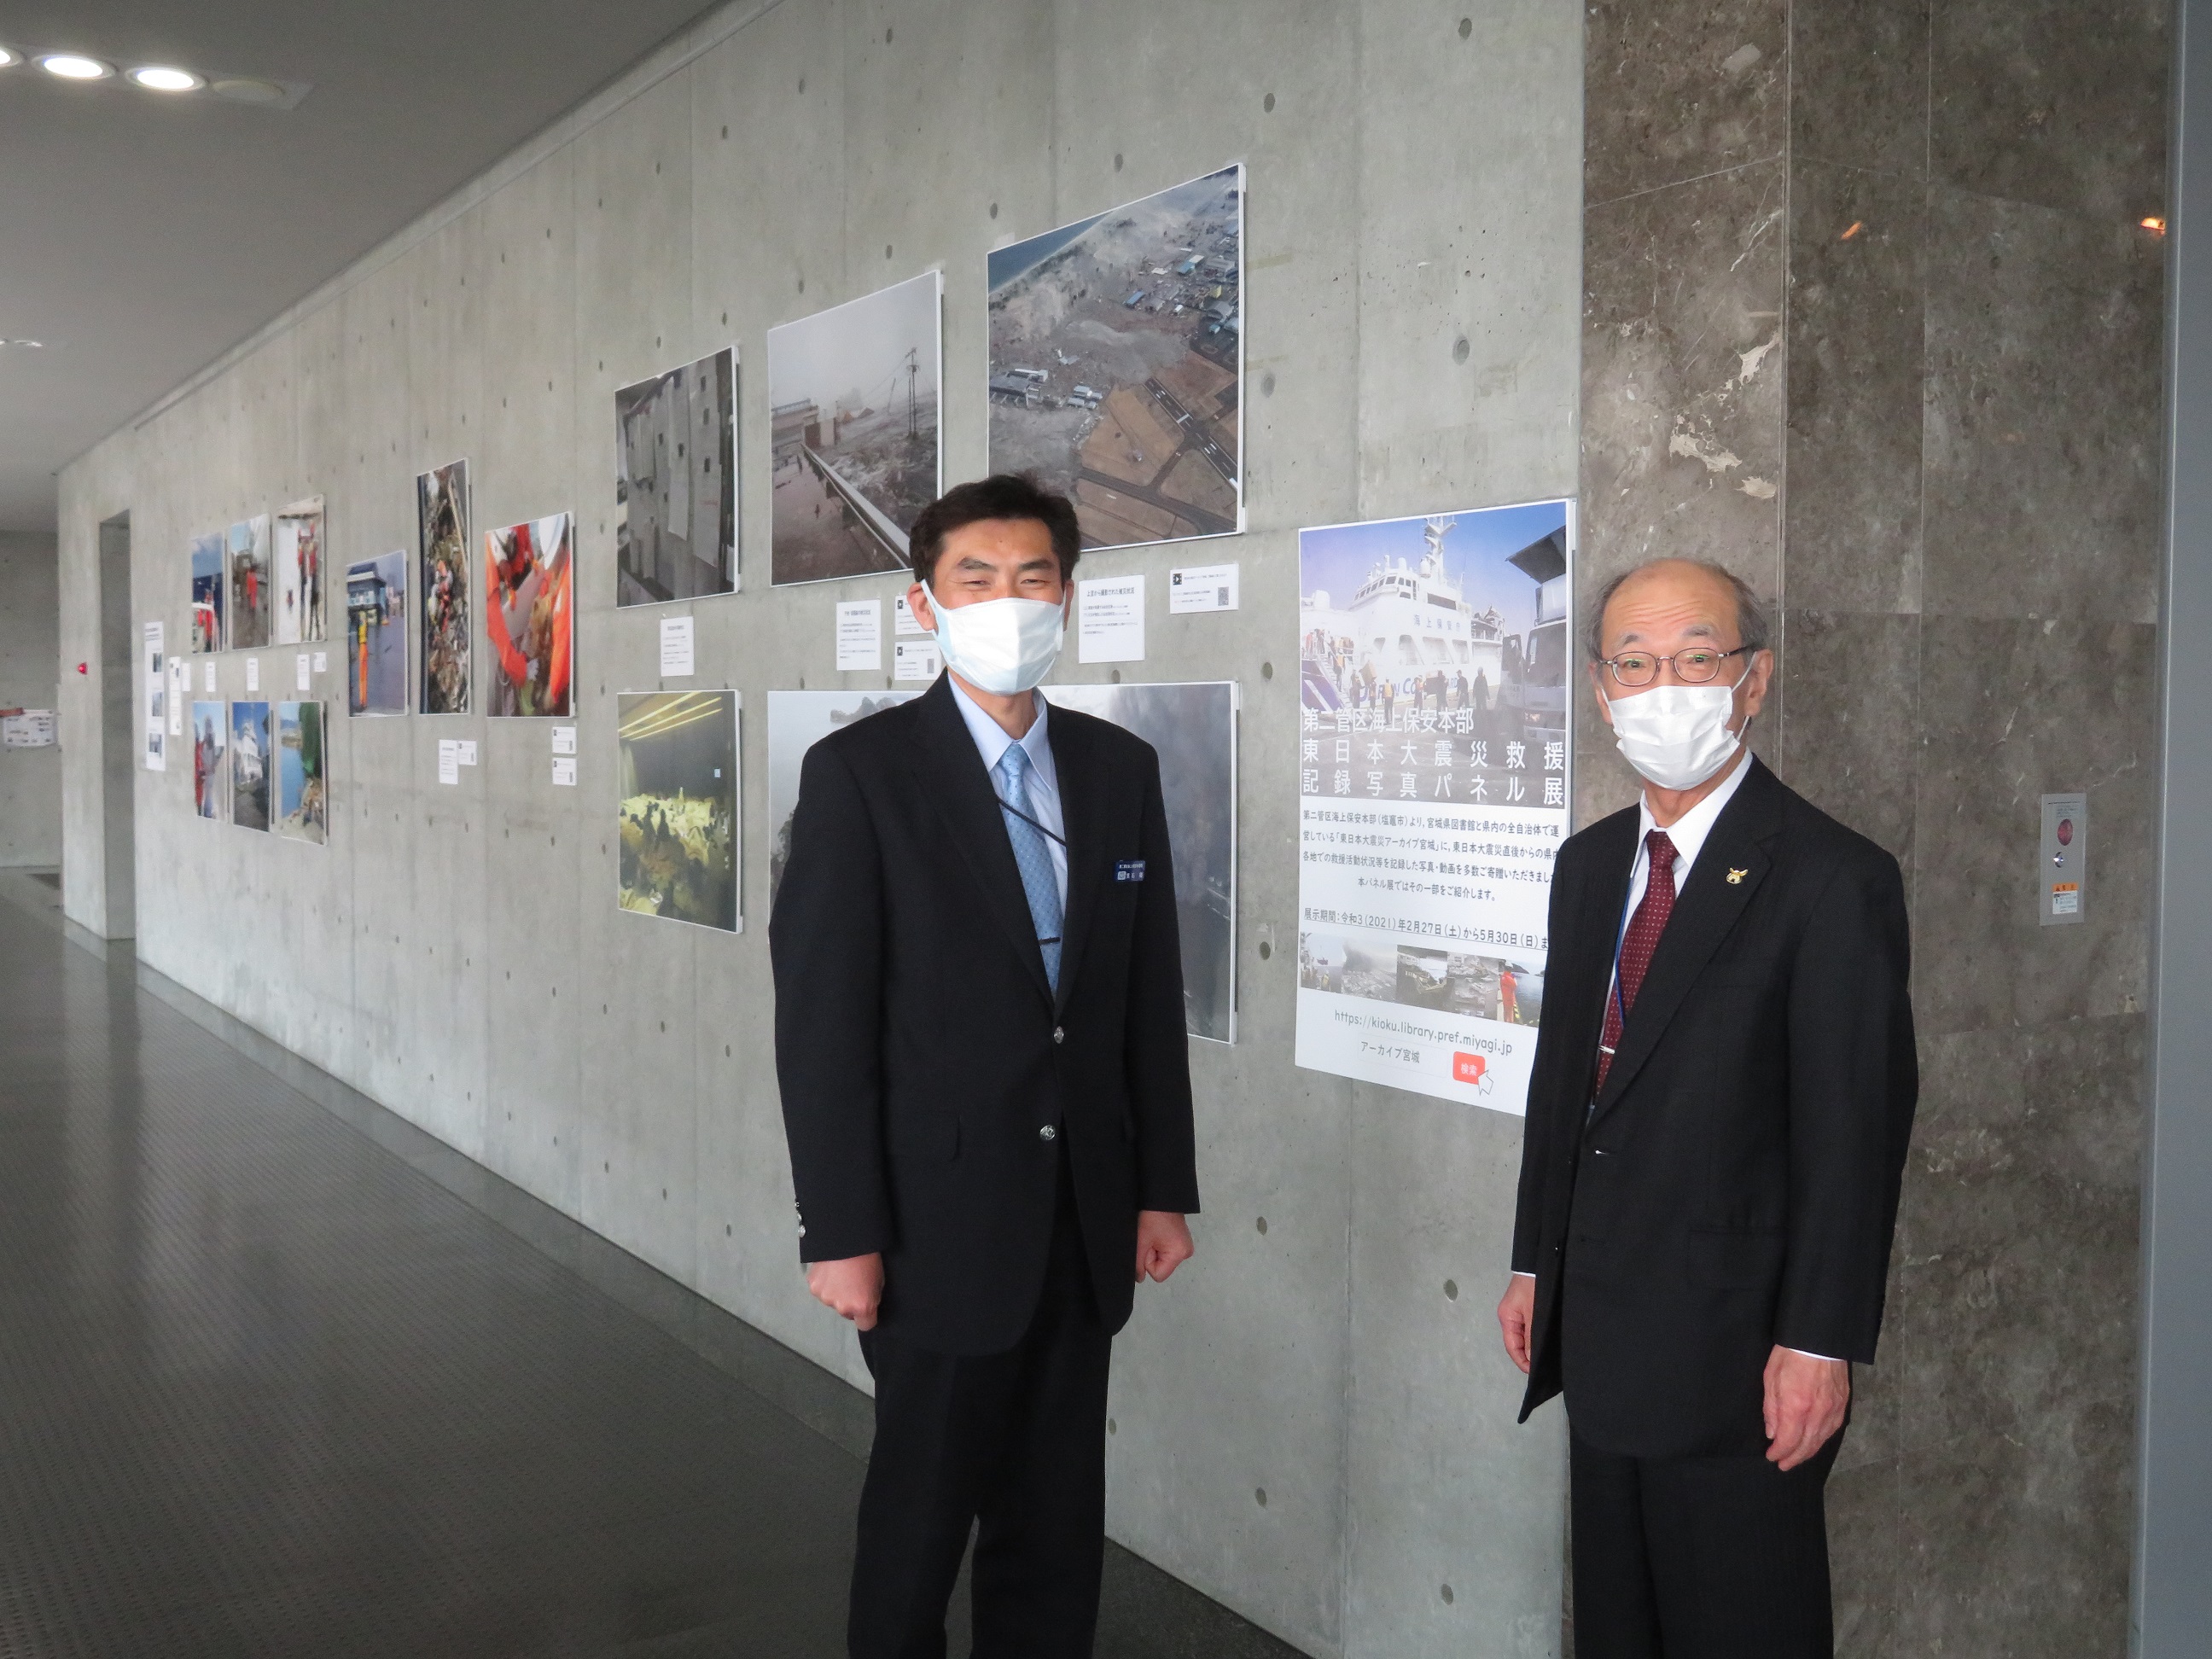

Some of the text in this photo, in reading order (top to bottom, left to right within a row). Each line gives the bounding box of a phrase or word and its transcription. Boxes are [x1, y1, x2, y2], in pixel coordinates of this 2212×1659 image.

[1303, 707, 1475, 734] 第二管区海上保安本部
[1302, 738, 1564, 771] 東日本大震災救援
[1302, 769, 1564, 806] 記録写真パネル展
[1302, 852, 1553, 883] 各地での救援活動状況等を記録した写真・動画を多数ご寄贈いただきまし
[1358, 876, 1495, 902] 本パネル展ではその一部をご紹介します。
[1335, 1010, 1512, 1055] https://kioku.library.pref.miyagi.jp
[1361, 1041, 1420, 1063] アーカイブ宮城
